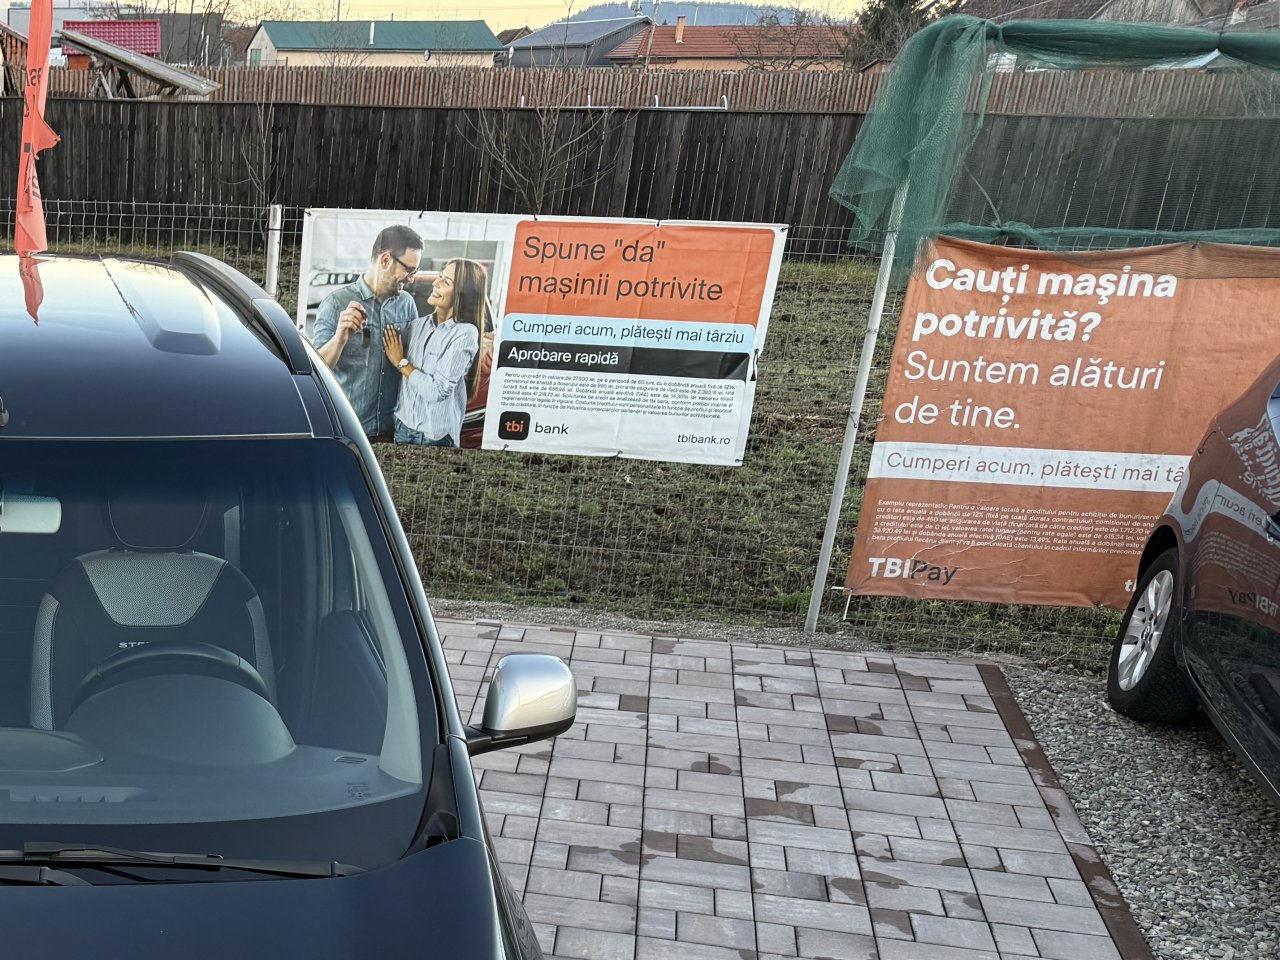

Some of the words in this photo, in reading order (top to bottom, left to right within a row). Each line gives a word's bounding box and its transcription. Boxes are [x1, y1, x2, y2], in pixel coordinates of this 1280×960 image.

[523, 236, 606, 264] Spune
[614, 239, 666, 263] "da"
[518, 273, 610, 300] mașinii
[616, 277, 723, 301] potrivite
[925, 258, 1030, 304] Cauți
[512, 319, 571, 337] Cumperi
[574, 325, 617, 339] acum,
[675, 329, 702, 342] mai
[705, 328, 745, 344] târziu
[912, 307, 1102, 342] potrivită?
[507, 347, 572, 364] Aprobare
[575, 351, 619, 366] rapidă
[904, 350, 1039, 385] Suntem
[1049, 359, 1165, 390] alături
[894, 396, 938, 425] de
[948, 398, 1020, 429] tine.
[505, 420, 524, 432] tbi
[534, 422, 569, 435] bank
[677, 434, 731, 445] tbibank.ro
[887, 452, 970, 477] Cumperi
[976, 459, 1035, 478] acum,
[1122, 465, 1160, 482] mai
[1166, 466, 1184, 482] tâ
[868, 557, 958, 586] TBIPay
